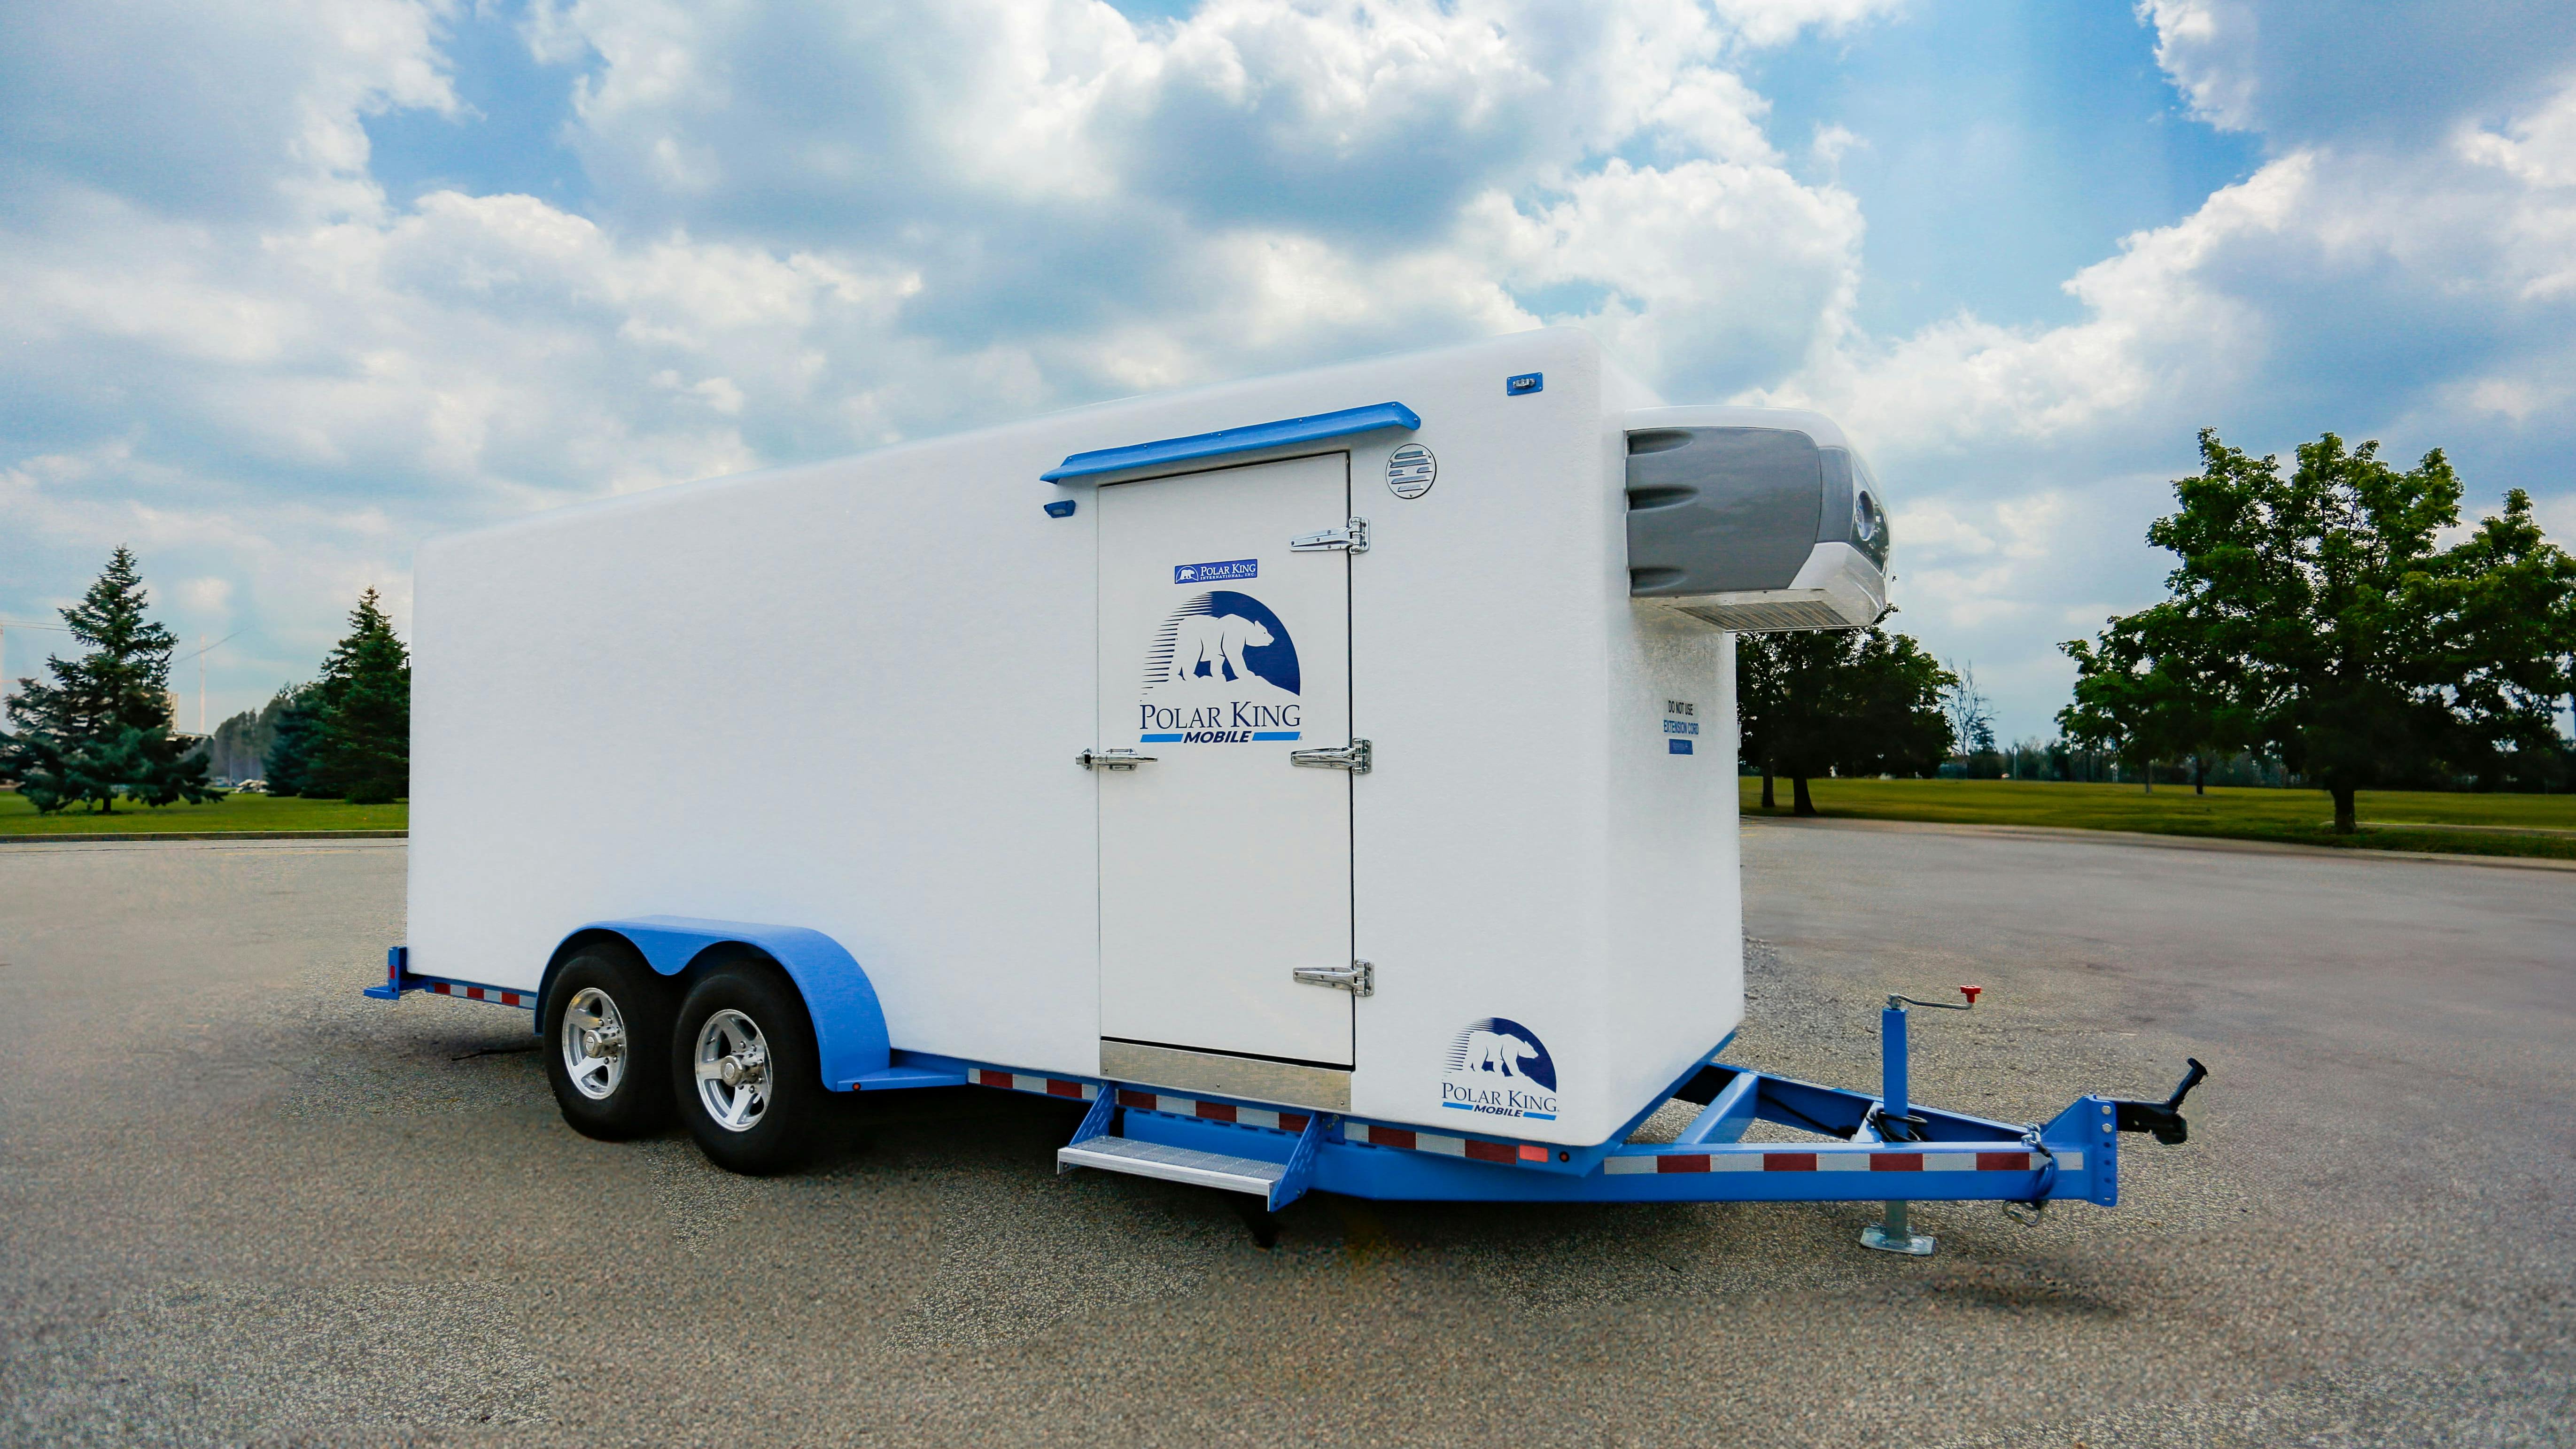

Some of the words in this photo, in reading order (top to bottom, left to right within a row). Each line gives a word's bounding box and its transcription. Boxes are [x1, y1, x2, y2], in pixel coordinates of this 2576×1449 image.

[1200, 566, 1230, 576] POLAR
[1232, 563, 1256, 574] KING
[1140, 704, 1222, 729] POLAR
[1230, 701, 1301, 728] KING
[1668, 700, 1675, 713] DO
[1676, 702, 1684, 714] NOT
[1684, 703, 1693, 716] USE
[1663, 720, 1687, 734] EXTENSION
[1183, 730, 1252, 744] MOBILE
[1441, 1082, 1502, 1105] POLAR
[1507, 1090, 1557, 1112] KING
[1474, 1105, 1523, 1117] MOBILE
